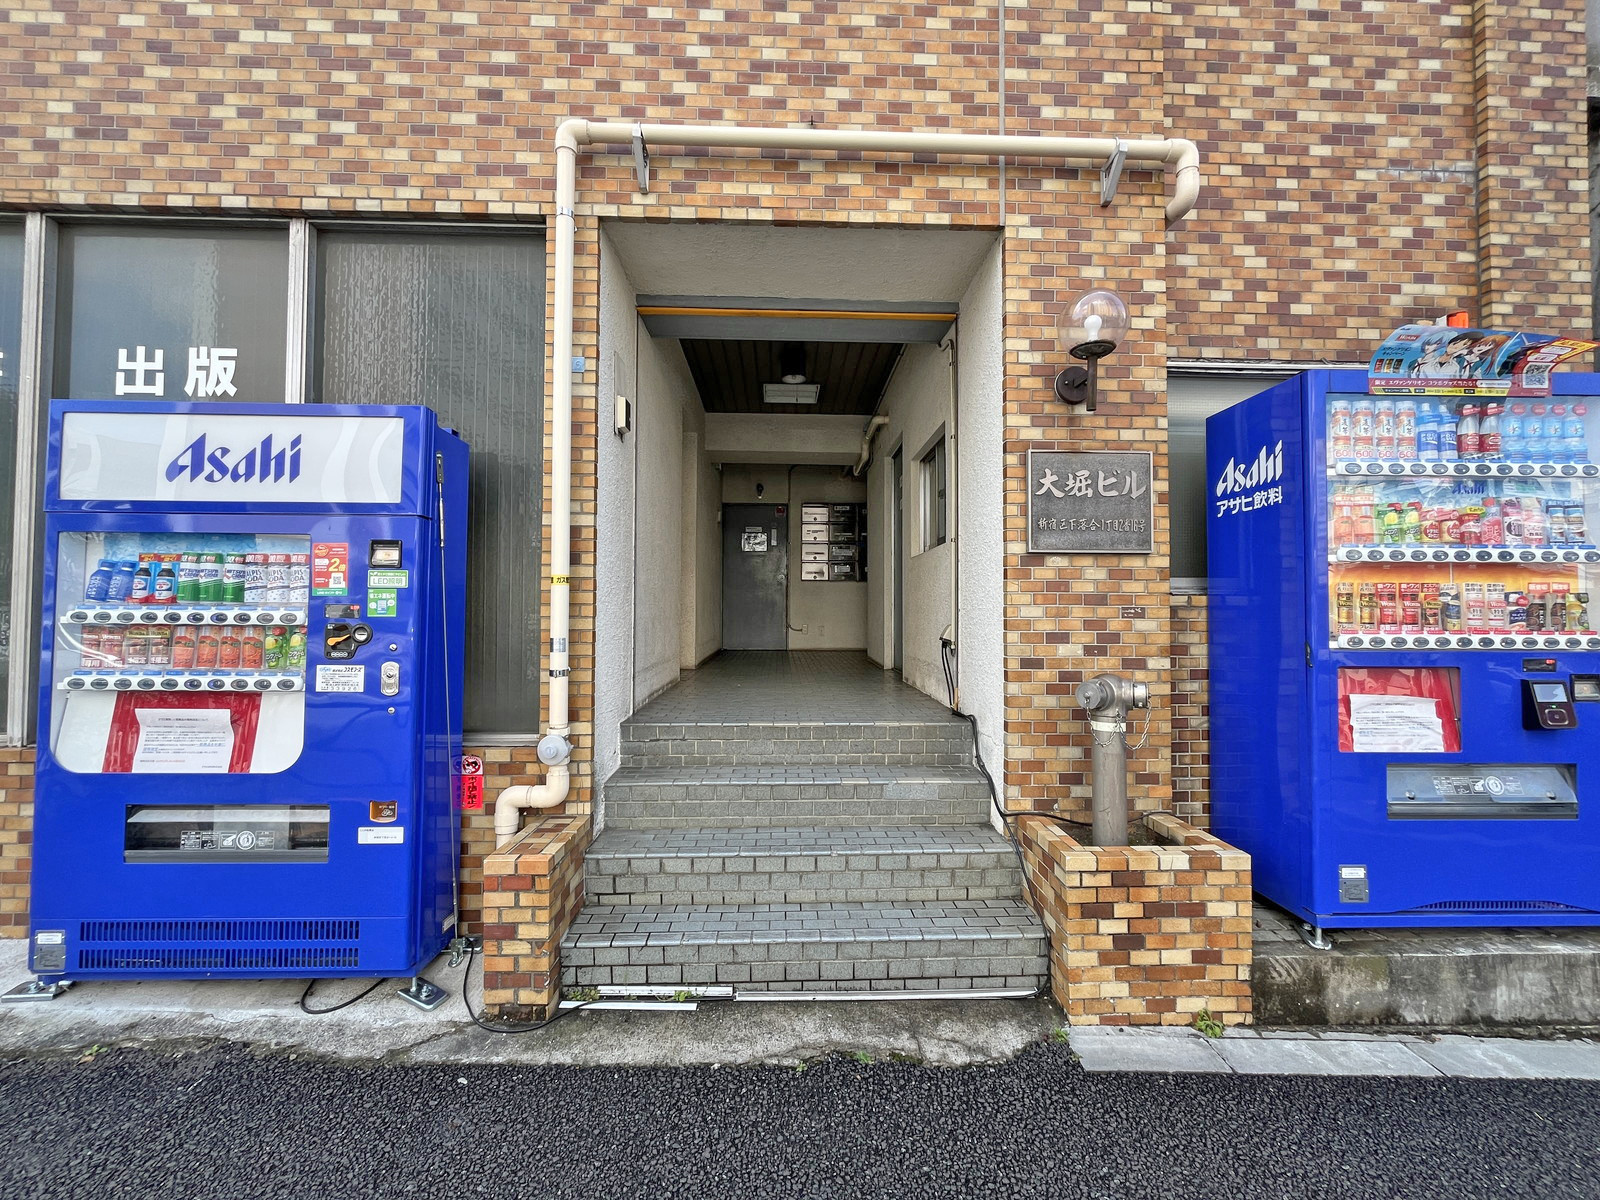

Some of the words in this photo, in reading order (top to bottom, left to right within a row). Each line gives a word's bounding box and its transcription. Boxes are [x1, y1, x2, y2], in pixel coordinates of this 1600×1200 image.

[115, 346, 238, 397] 出版
[165, 433, 302, 484] Asahi
[1216, 440, 1283, 498] Asahi
[1035, 468, 1146, 499] 大堀ビル
[1216, 486, 1283, 517] アサヒ飲料
[1038, 518, 1146, 533] 新宿区下落合1丁目2番16号
